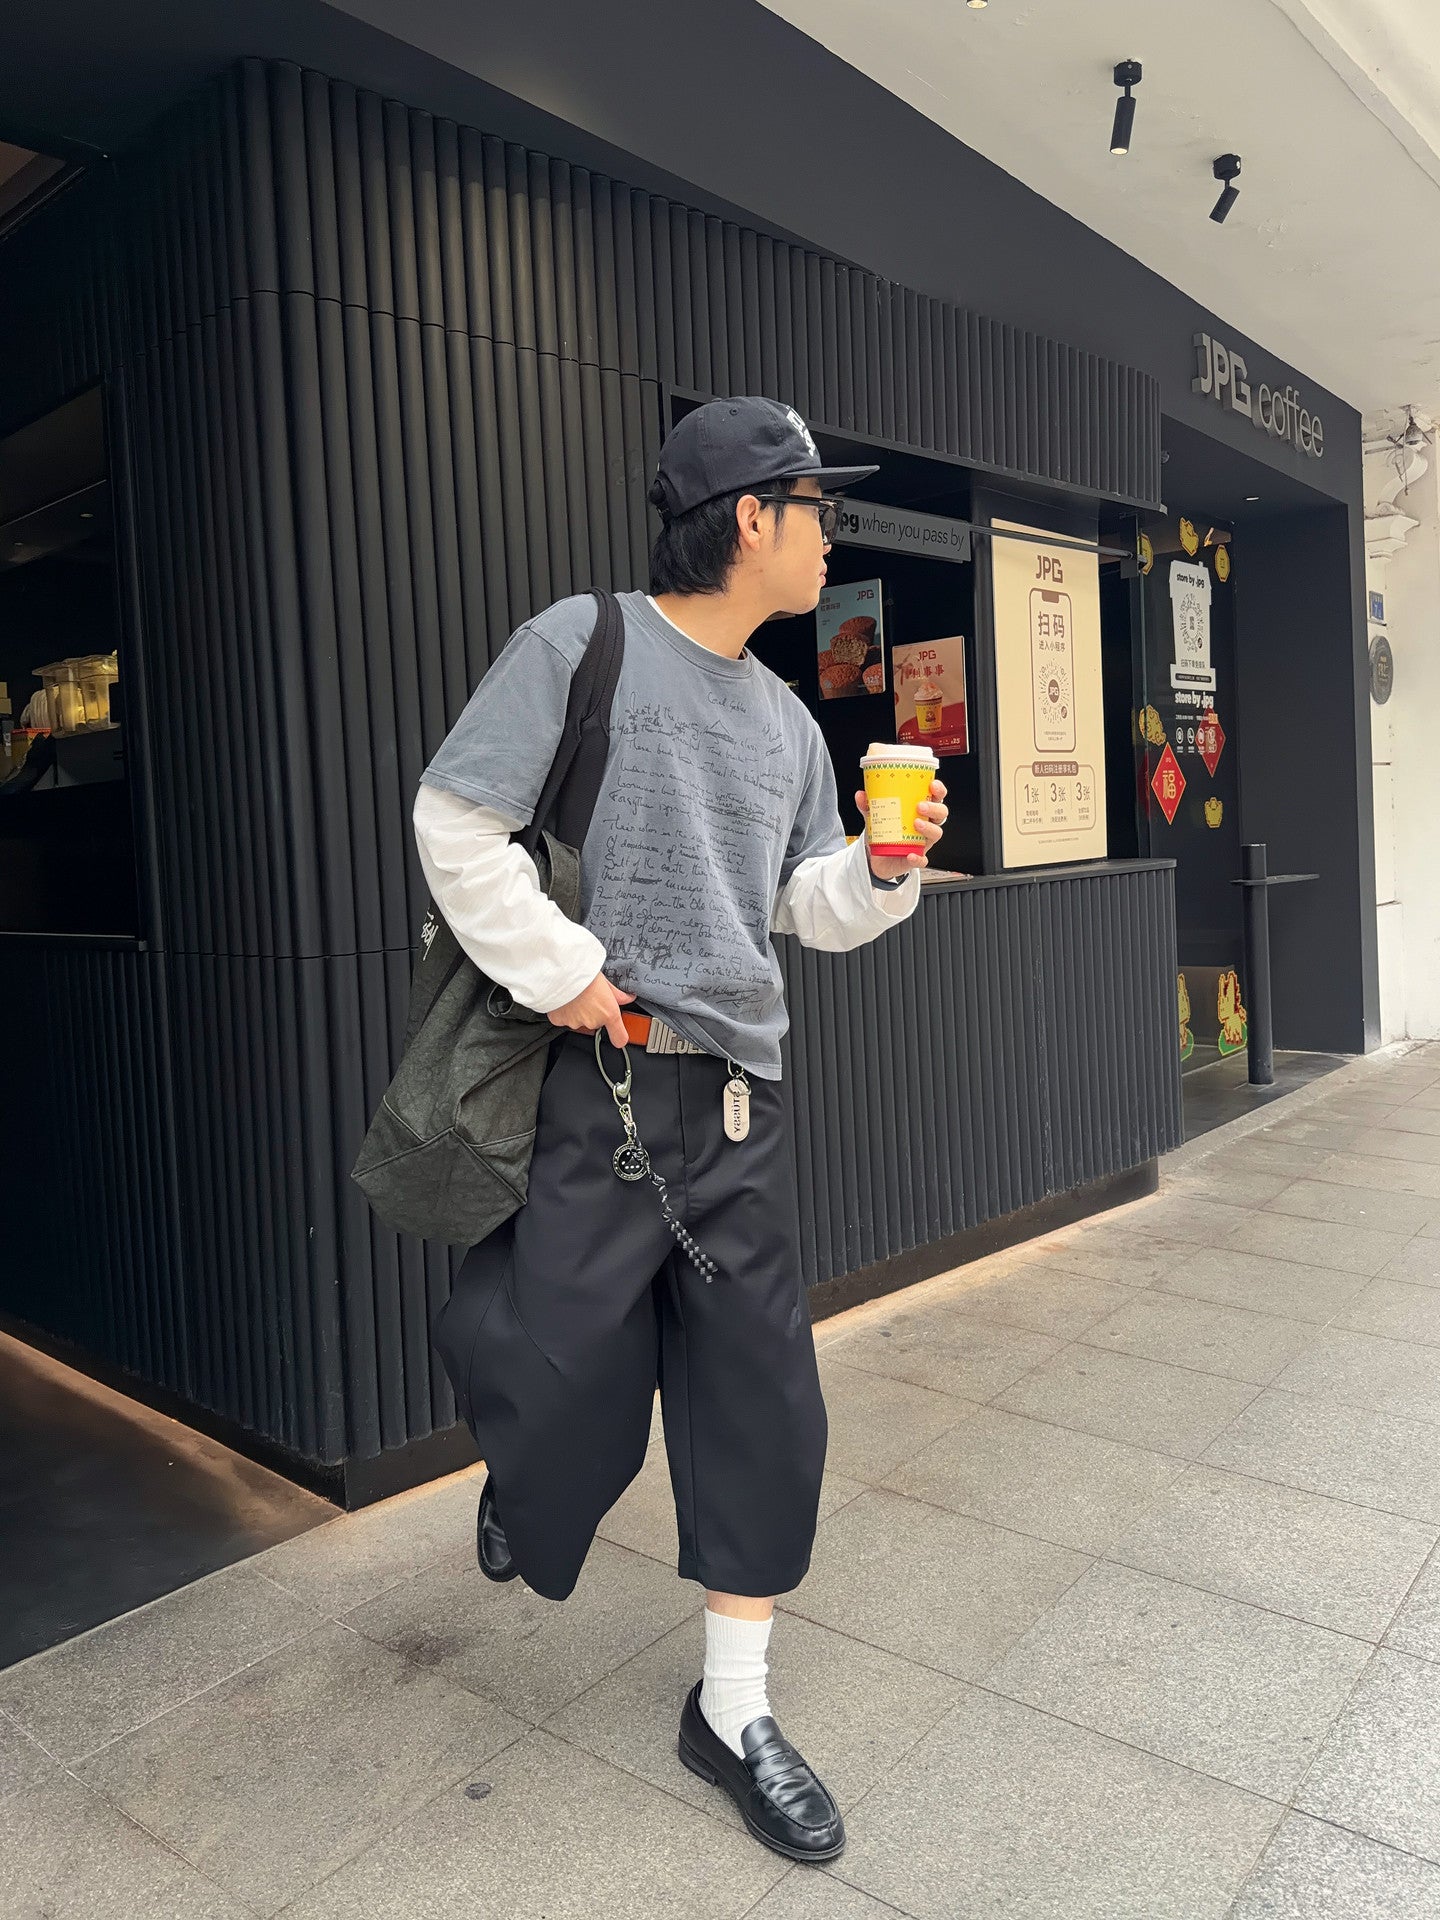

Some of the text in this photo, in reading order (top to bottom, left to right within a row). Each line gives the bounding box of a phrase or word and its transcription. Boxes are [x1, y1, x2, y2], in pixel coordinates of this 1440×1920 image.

[1193, 333, 1324, 458] JPG coffee
[840, 512, 964, 551] pg when you pass by
[1036, 555, 1063, 583] JPG
[1176, 573, 1188, 583] store
[1189, 574, 1195, 586] by
[857, 589, 874, 601] JPG
[1038, 611, 1064, 638] 扫码
[917, 650, 936, 661] JPG
[1174, 691, 1191, 704] store
[1192, 691, 1201, 708] by
[1050, 782, 1067, 802] 3张
[1075, 782, 1091, 801] 3张
